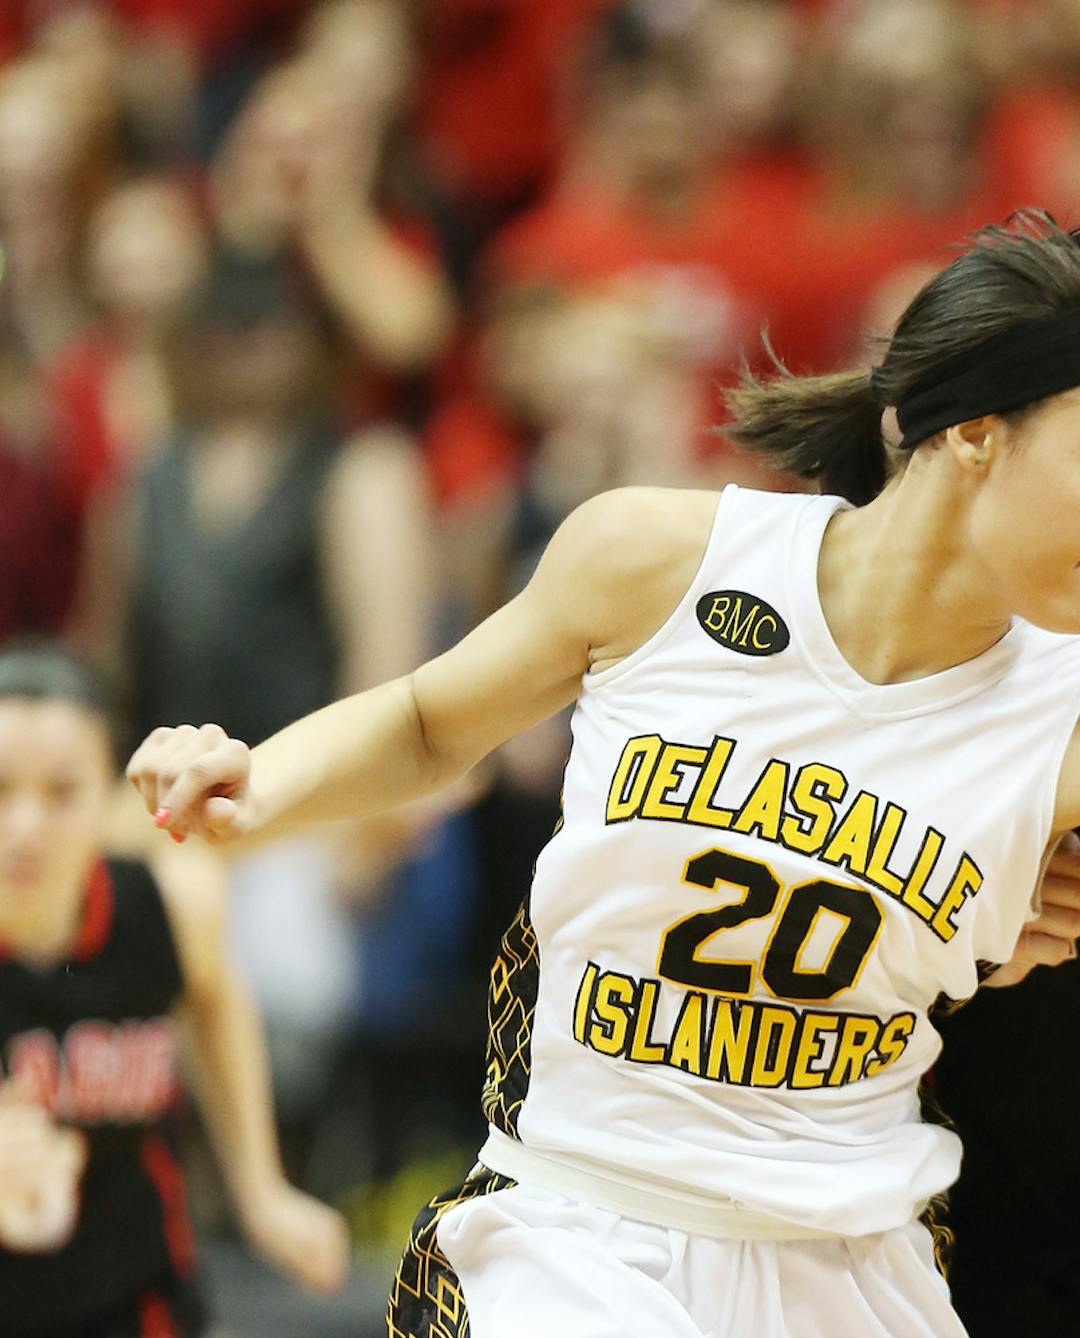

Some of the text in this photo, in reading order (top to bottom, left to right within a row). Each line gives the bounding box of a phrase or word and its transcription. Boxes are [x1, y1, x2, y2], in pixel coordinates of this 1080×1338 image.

[703, 595, 777, 650] BMC
[605, 733, 984, 943] DELASALLE
[655, 846, 886, 1003] 20
[572, 960, 918, 1091] ISLANDERS
